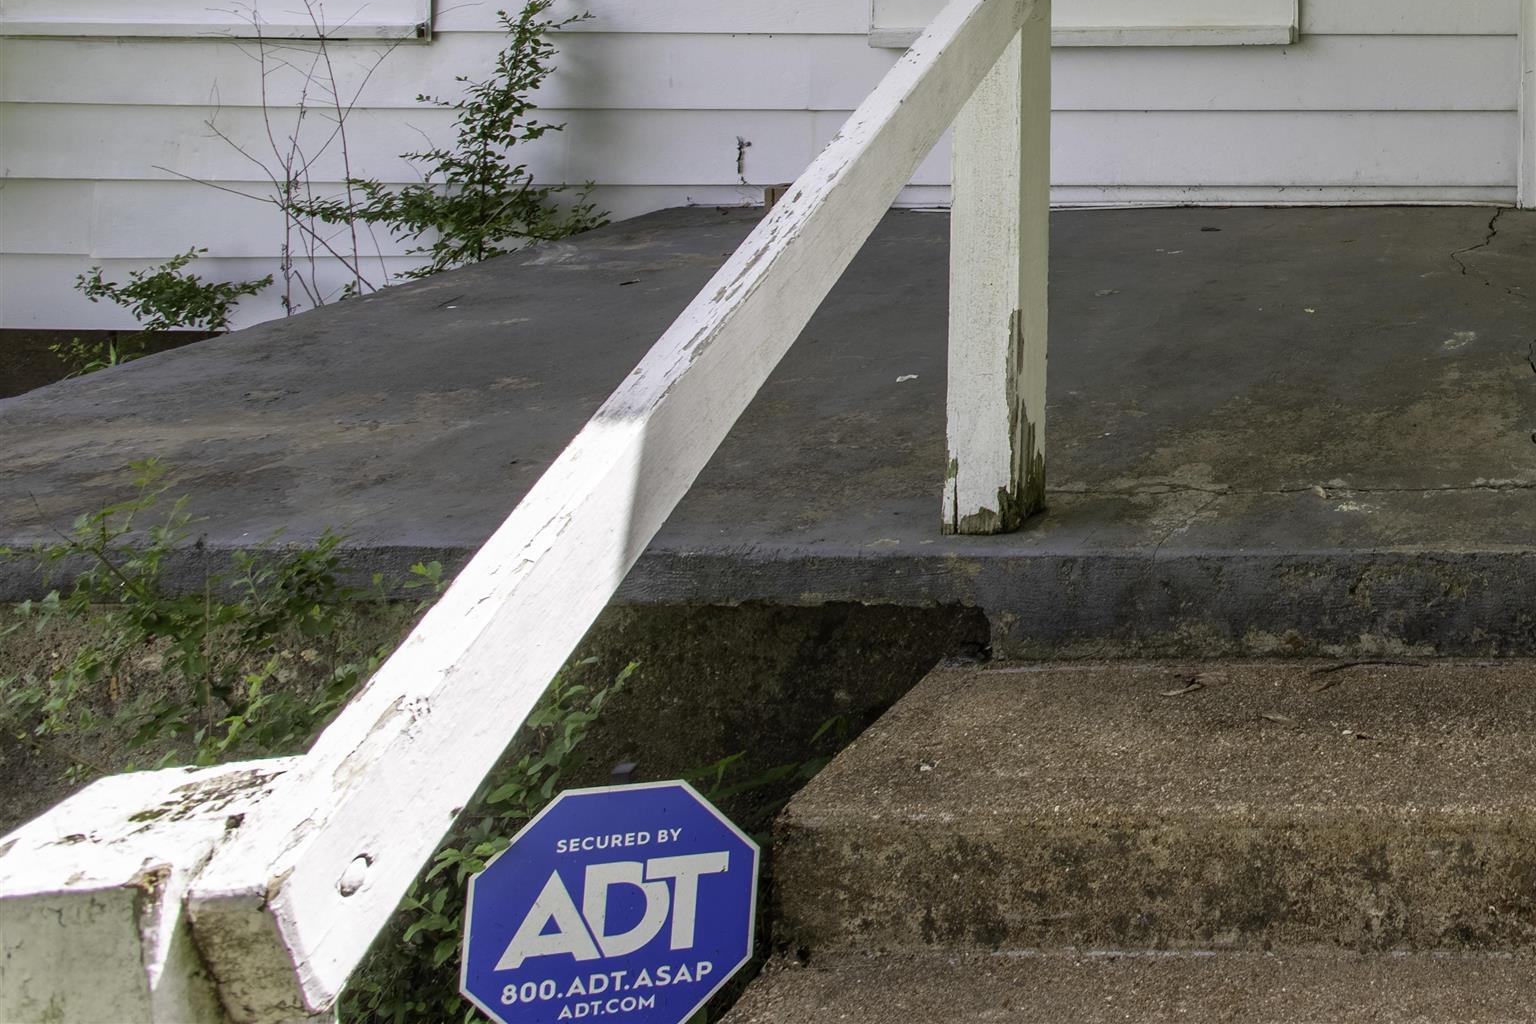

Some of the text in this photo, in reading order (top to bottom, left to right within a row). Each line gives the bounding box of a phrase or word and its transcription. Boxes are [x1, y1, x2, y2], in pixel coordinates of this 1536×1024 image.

[556, 827, 682, 853] SECURED BY
[493, 850, 730, 972] ADT
[500, 961, 714, 1006] 800.ADT.ASAP
[556, 993, 656, 1021] ADT.COM
